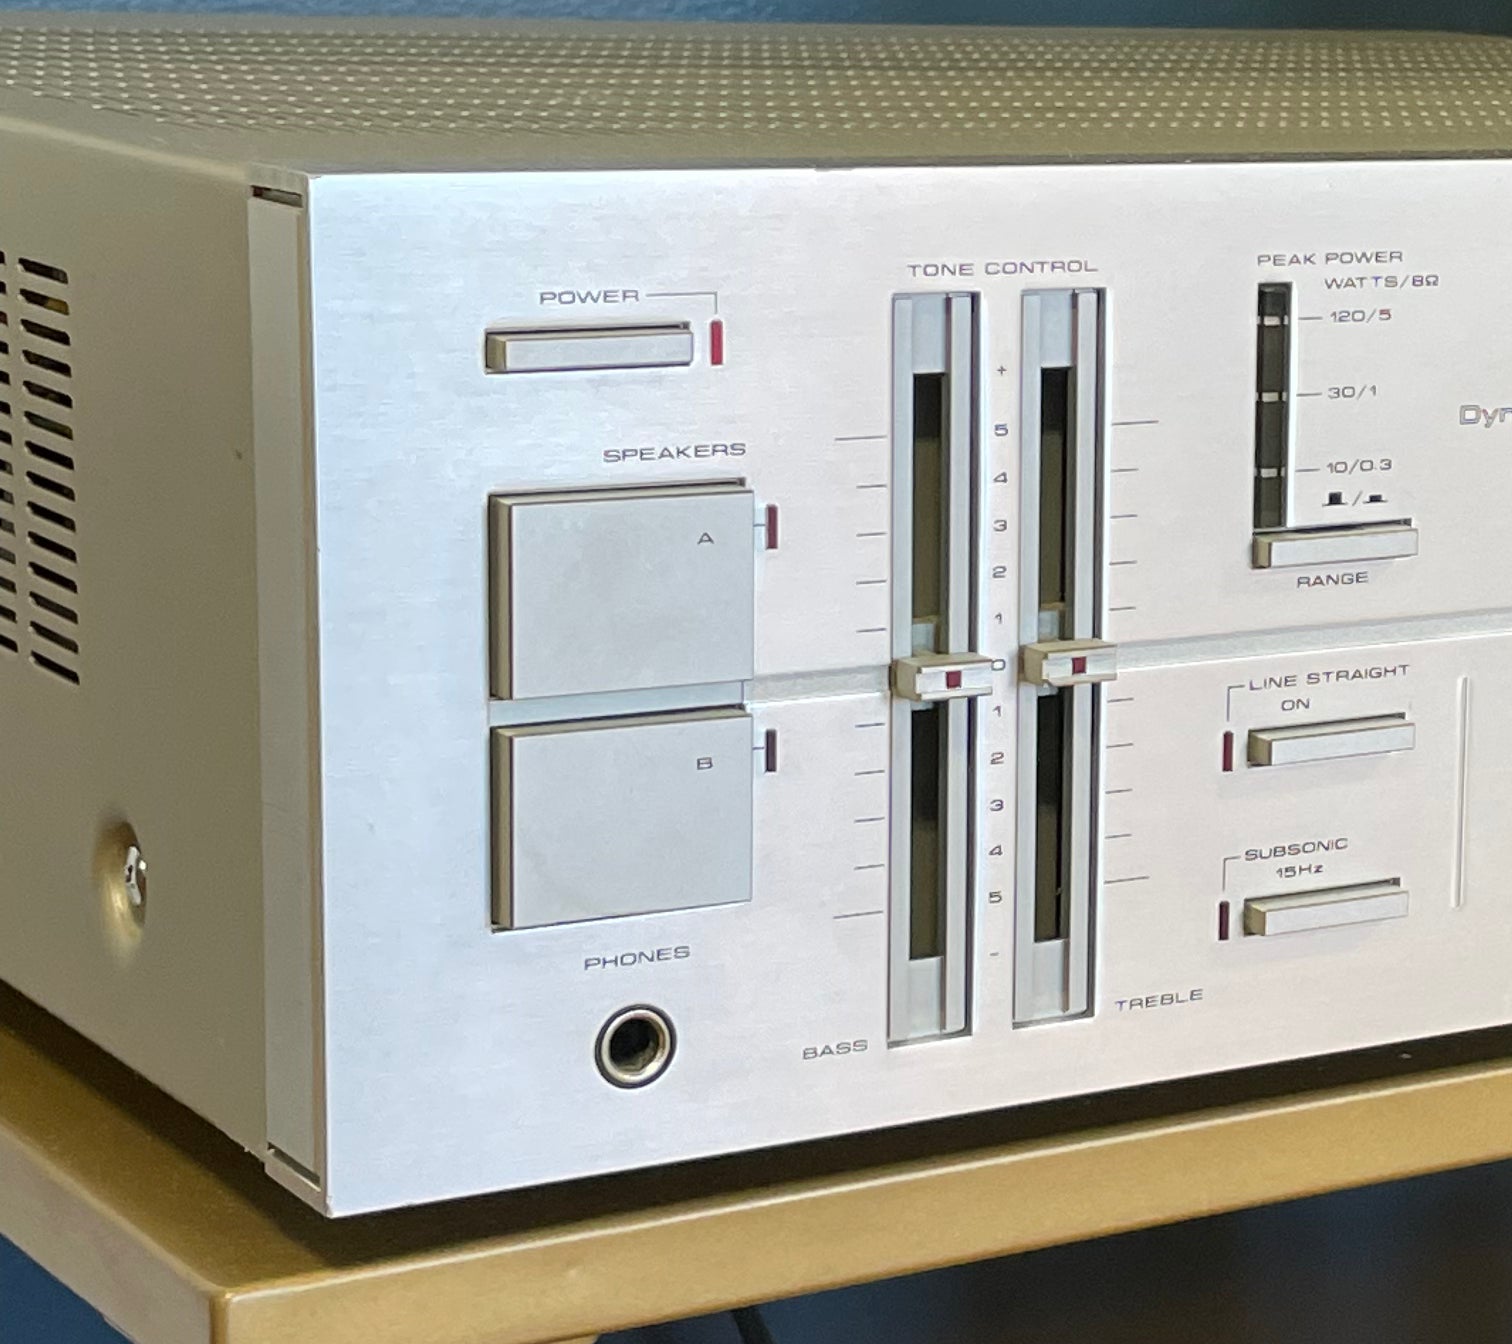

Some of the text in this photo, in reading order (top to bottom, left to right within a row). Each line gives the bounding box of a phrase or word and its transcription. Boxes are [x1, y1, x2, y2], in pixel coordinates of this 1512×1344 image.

[1257, 251, 1403, 267] PEAK POWER
[906, 259, 1100, 279] TONE CONTROL
[539, 288, 640, 306] POWER
[1329, 308, 1392, 324] 120/5
[1327, 385, 1378, 400] 30/1
[993, 423, 1009, 437] 5
[602, 441, 747, 463] SPEAKERS
[1325, 458, 1393, 475] 10/0.3
[992, 471, 1008, 484] 4
[993, 518, 1008, 532] 3
[697, 532, 715, 545] A
[992, 566, 1007, 579] 2
[1296, 571, 1369, 588] RANGE
[994, 611, 1004, 625] 1
[1248, 664, 1411, 692] LINE STRAIGHT
[1280, 697, 1311, 712] ON
[696, 757, 713, 770] B
[989, 752, 1005, 766] 2
[989, 799, 1005, 812] 3
[988, 844, 1004, 857] 4
[1244, 837, 1350, 862] SUBSONIC
[1275, 863, 1325, 880] 15Hz
[988, 890, 1004, 904] 5
[583, 945, 692, 971] PHONES
[1115, 988, 1205, 1013] TREBLE
[801, 1039, 869, 1061] BASS
